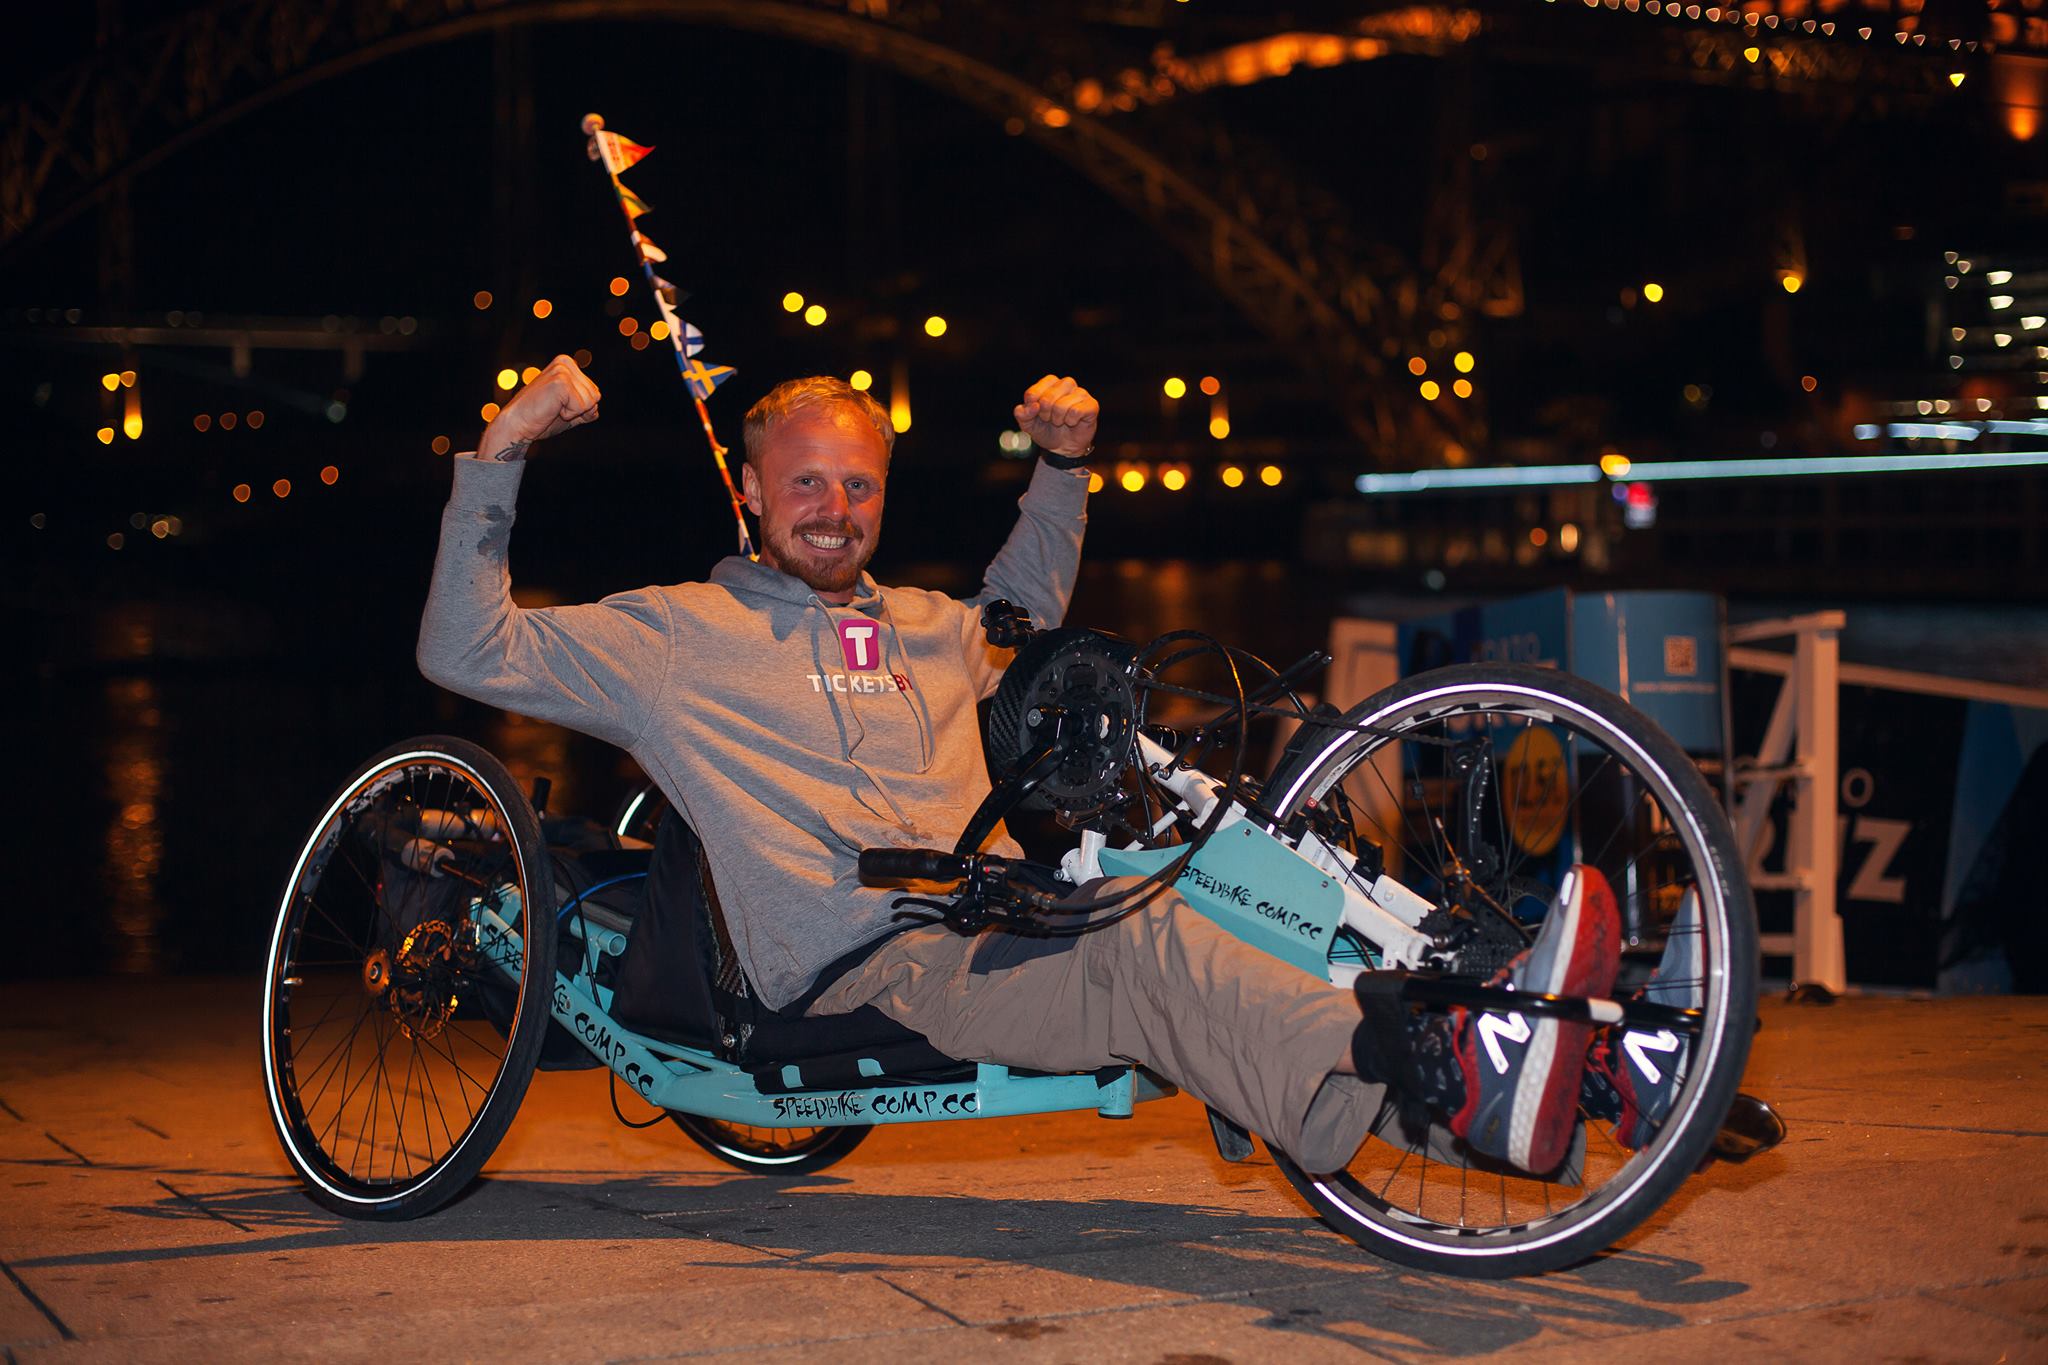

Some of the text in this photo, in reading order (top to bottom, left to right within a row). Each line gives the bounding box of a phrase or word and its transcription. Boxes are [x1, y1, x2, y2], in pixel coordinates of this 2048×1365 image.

[845, 626, 873, 666] T
[1180, 863, 1323, 940] SPEEDBIKE COMP.CC
[574, 1011, 655, 1097] COMP.CC
[773, 1090, 978, 1120] SPEEDBIKE COMP.CC
